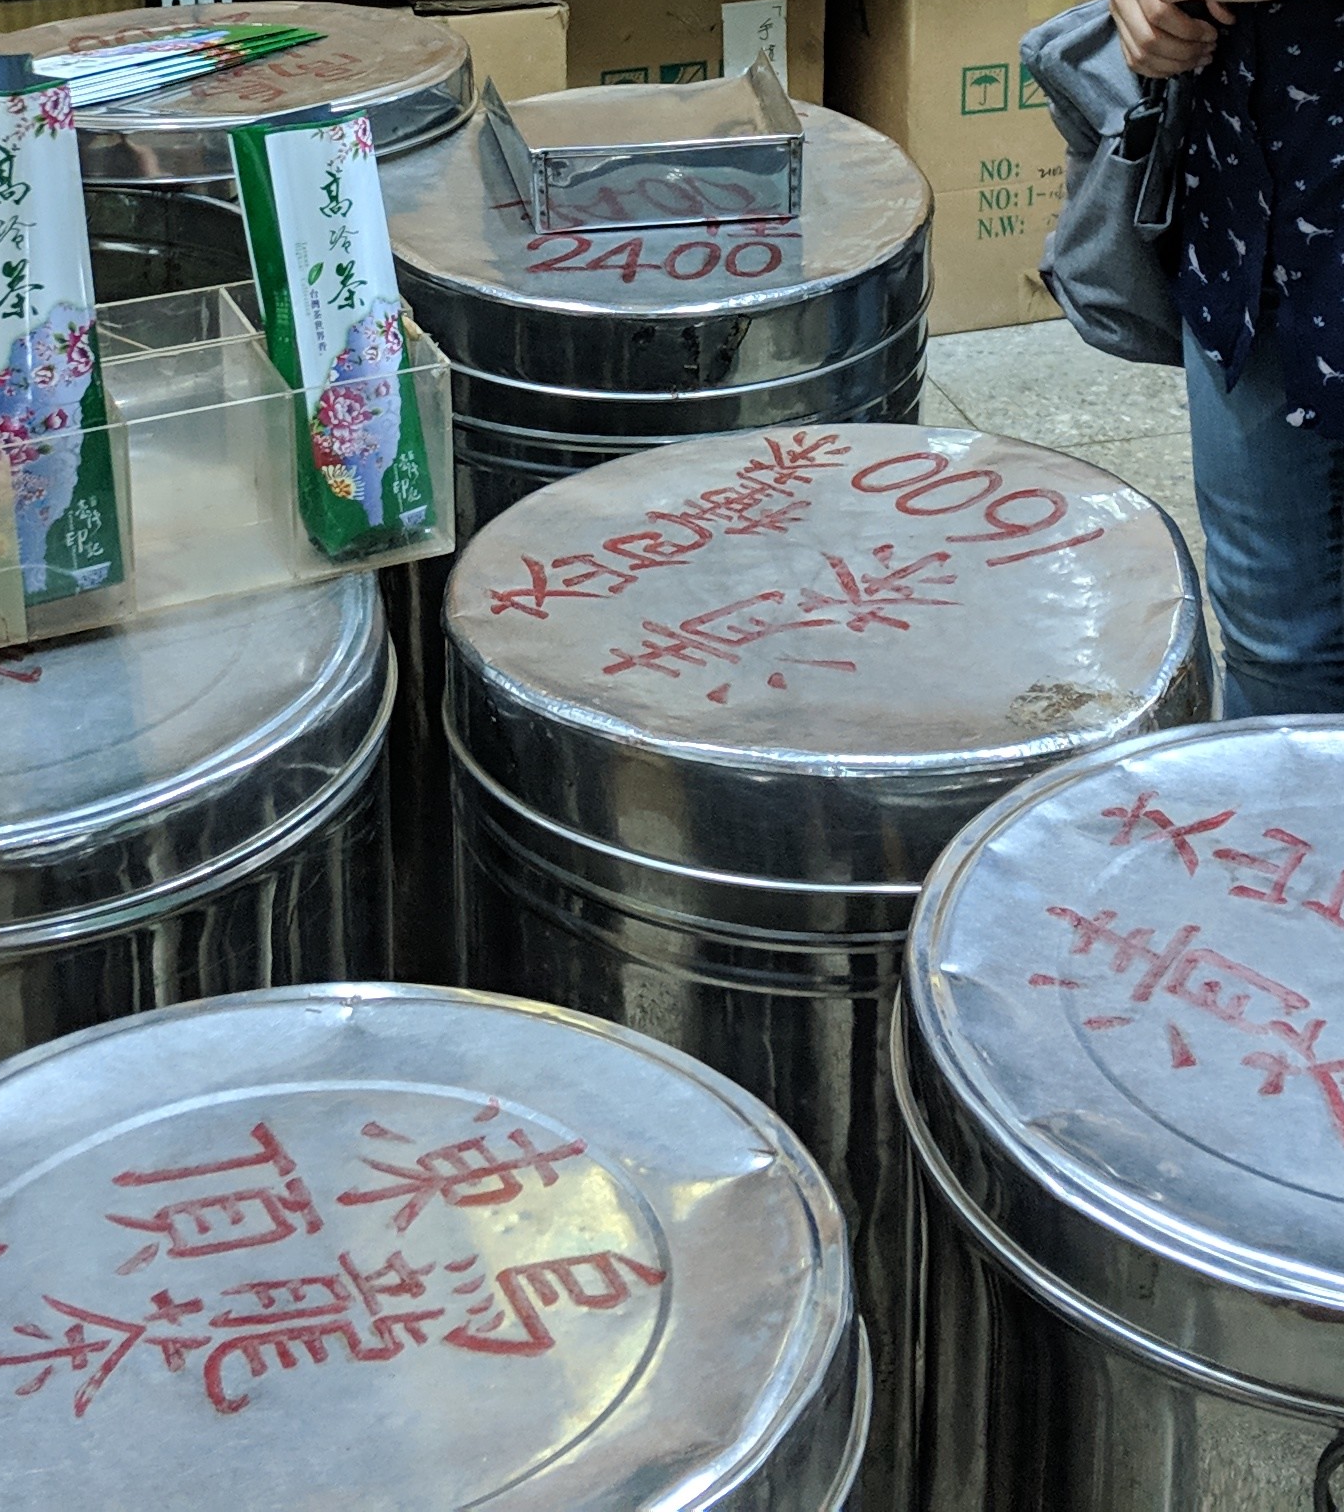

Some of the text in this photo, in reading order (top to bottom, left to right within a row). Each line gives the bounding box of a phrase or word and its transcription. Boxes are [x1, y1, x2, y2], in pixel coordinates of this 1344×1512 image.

[979, 156, 1020, 183] NO:
[977, 187, 1019, 213] NO:
[977, 214, 1025, 240] N.W:
[525, 233, 783, 284] 2400
[850, 451, 1106, 568] 1600
[602, 543, 963, 704] 清茶
[104, 1097, 588, 1276] 凍頂
